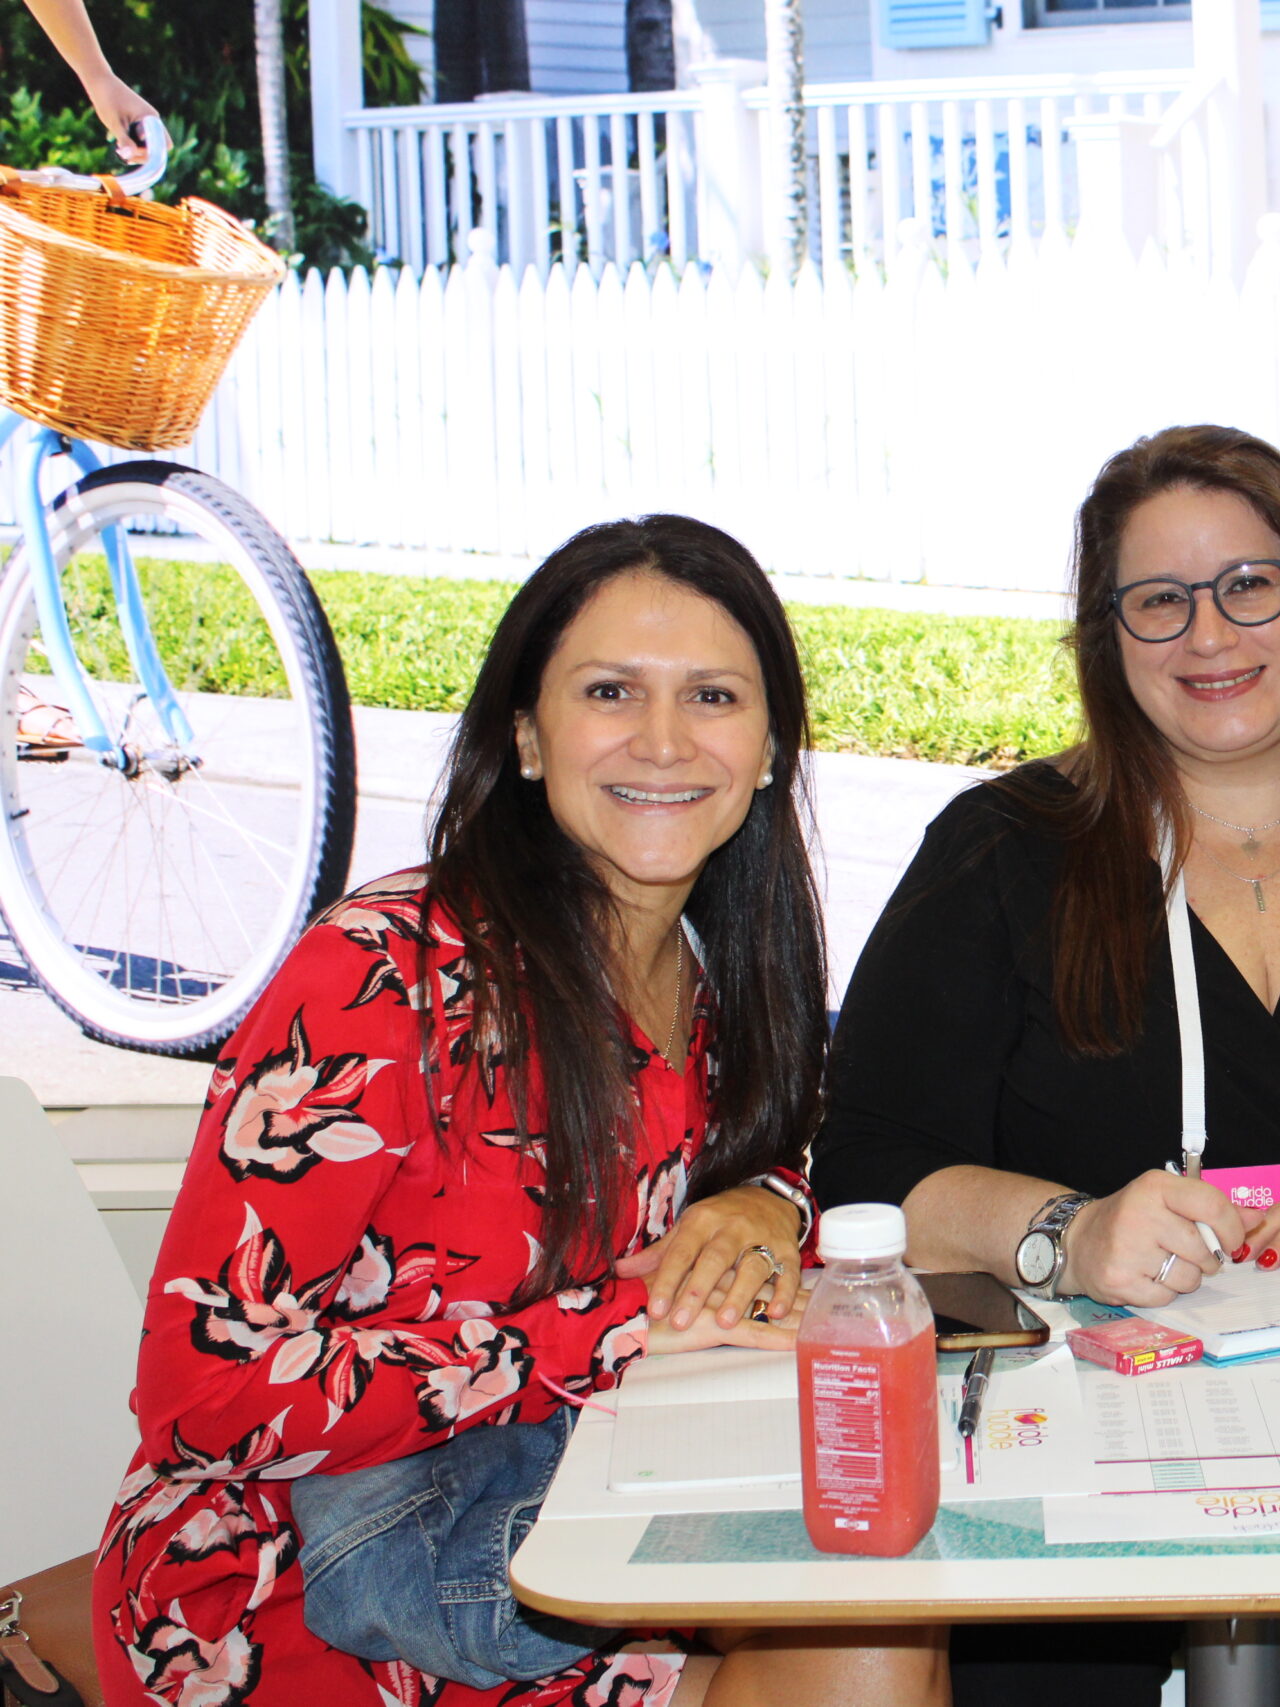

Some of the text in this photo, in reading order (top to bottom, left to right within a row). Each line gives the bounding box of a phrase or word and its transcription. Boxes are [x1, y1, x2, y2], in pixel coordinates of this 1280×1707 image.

[1231, 1186, 1272, 1200] florida
[813, 1361, 877, 1374] Nutrition Facts
[1137, 1363, 1154, 1374] mini
[1156, 1355, 1184, 1369] HALLS
[987, 1408, 1018, 1450] huddle
[1014, 1407, 1049, 1447] florida
